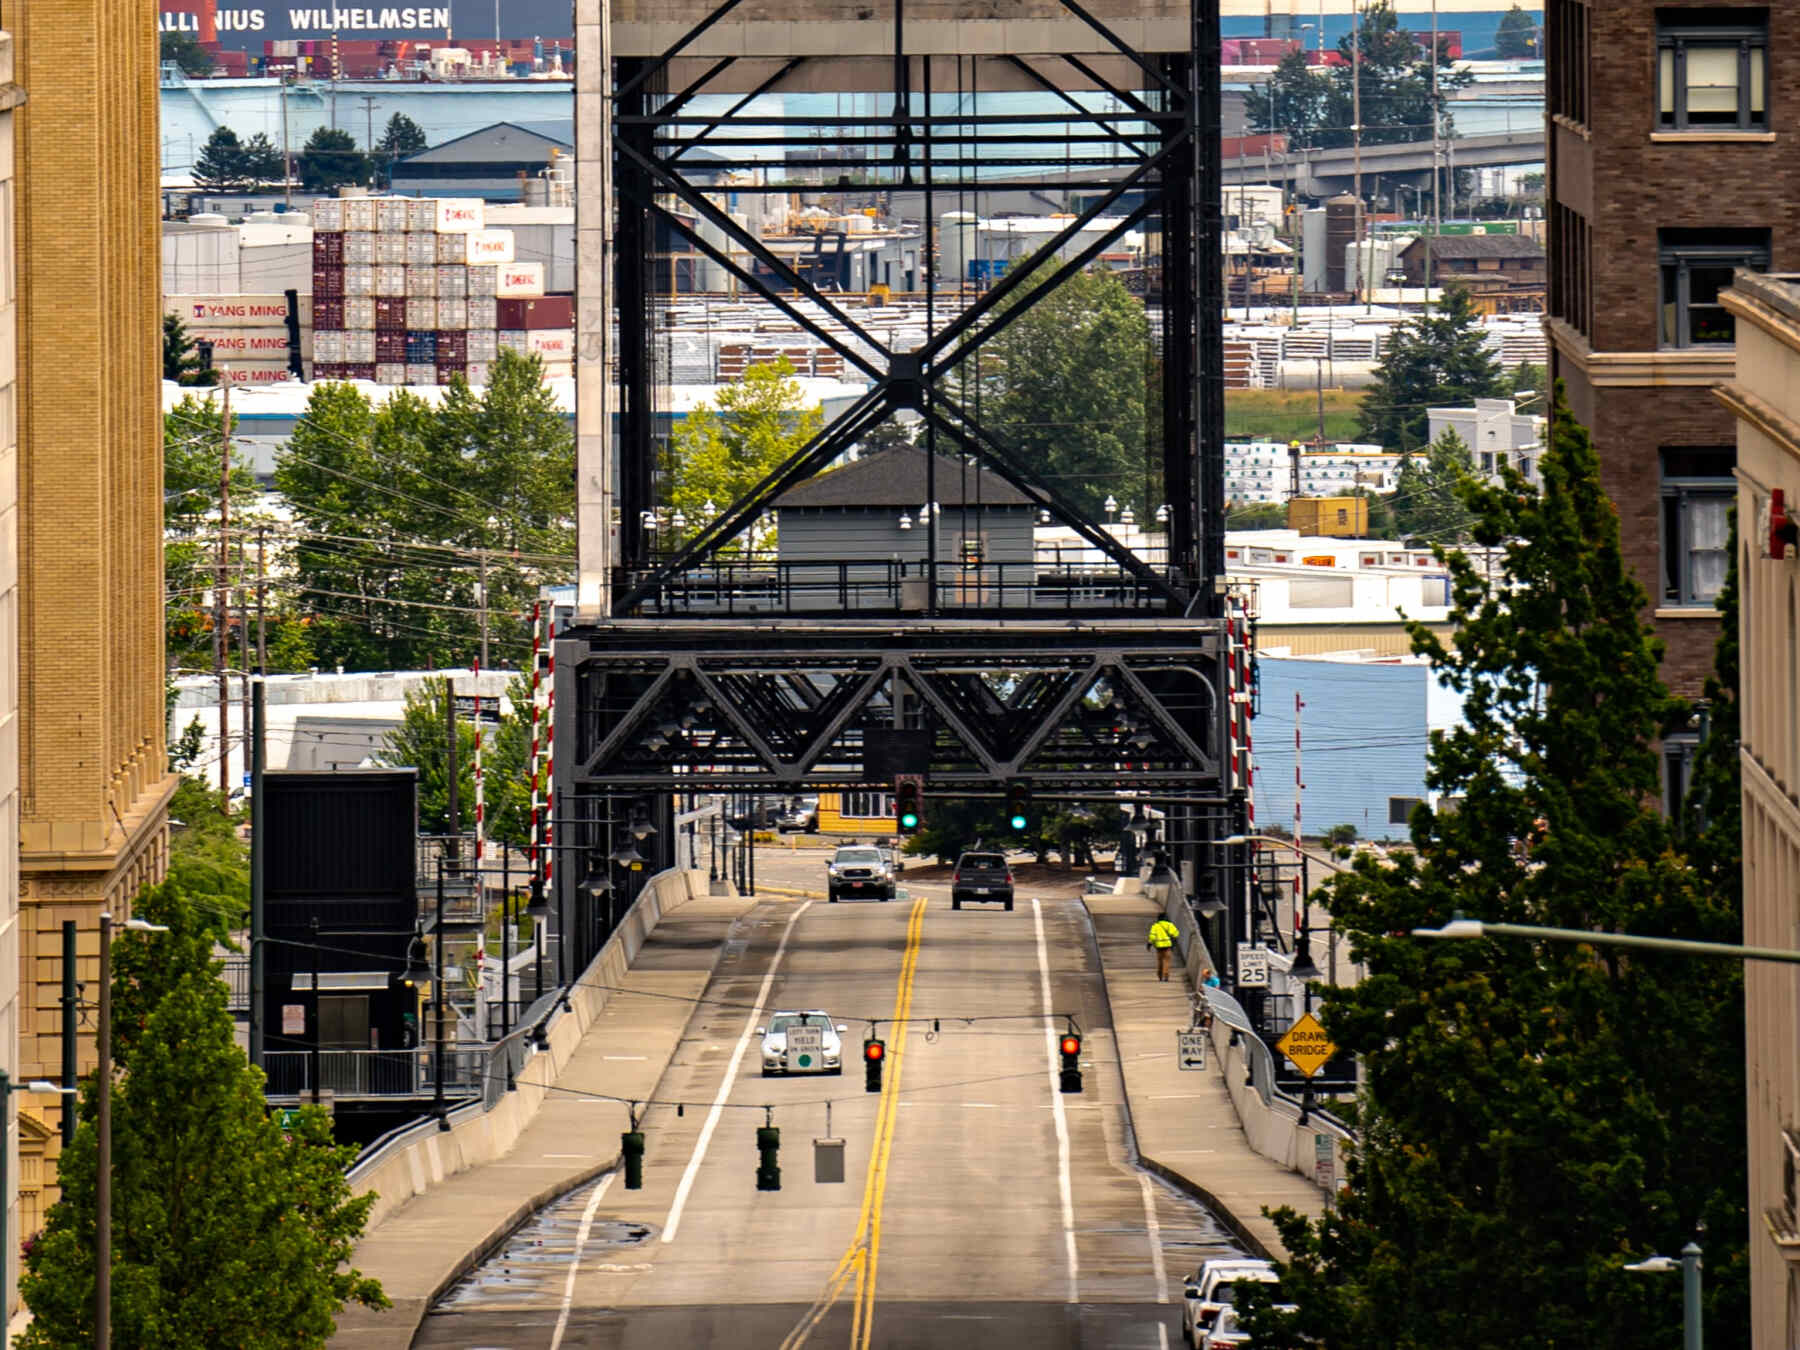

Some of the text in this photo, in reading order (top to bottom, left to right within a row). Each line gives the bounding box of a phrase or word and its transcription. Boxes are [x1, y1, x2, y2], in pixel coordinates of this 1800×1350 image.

[289, 8, 449, 30] WILHELMSEN
[208, 305, 287, 316] YANG MING
[250, 338, 287, 349] MING
[251, 370, 288, 381] MING
[1241, 968, 1265, 983] 25
[1182, 1036, 1202, 1046] ONE
[1182, 1047, 1202, 1056] WAY
[1289, 1044, 1328, 1056] BRIDGE
